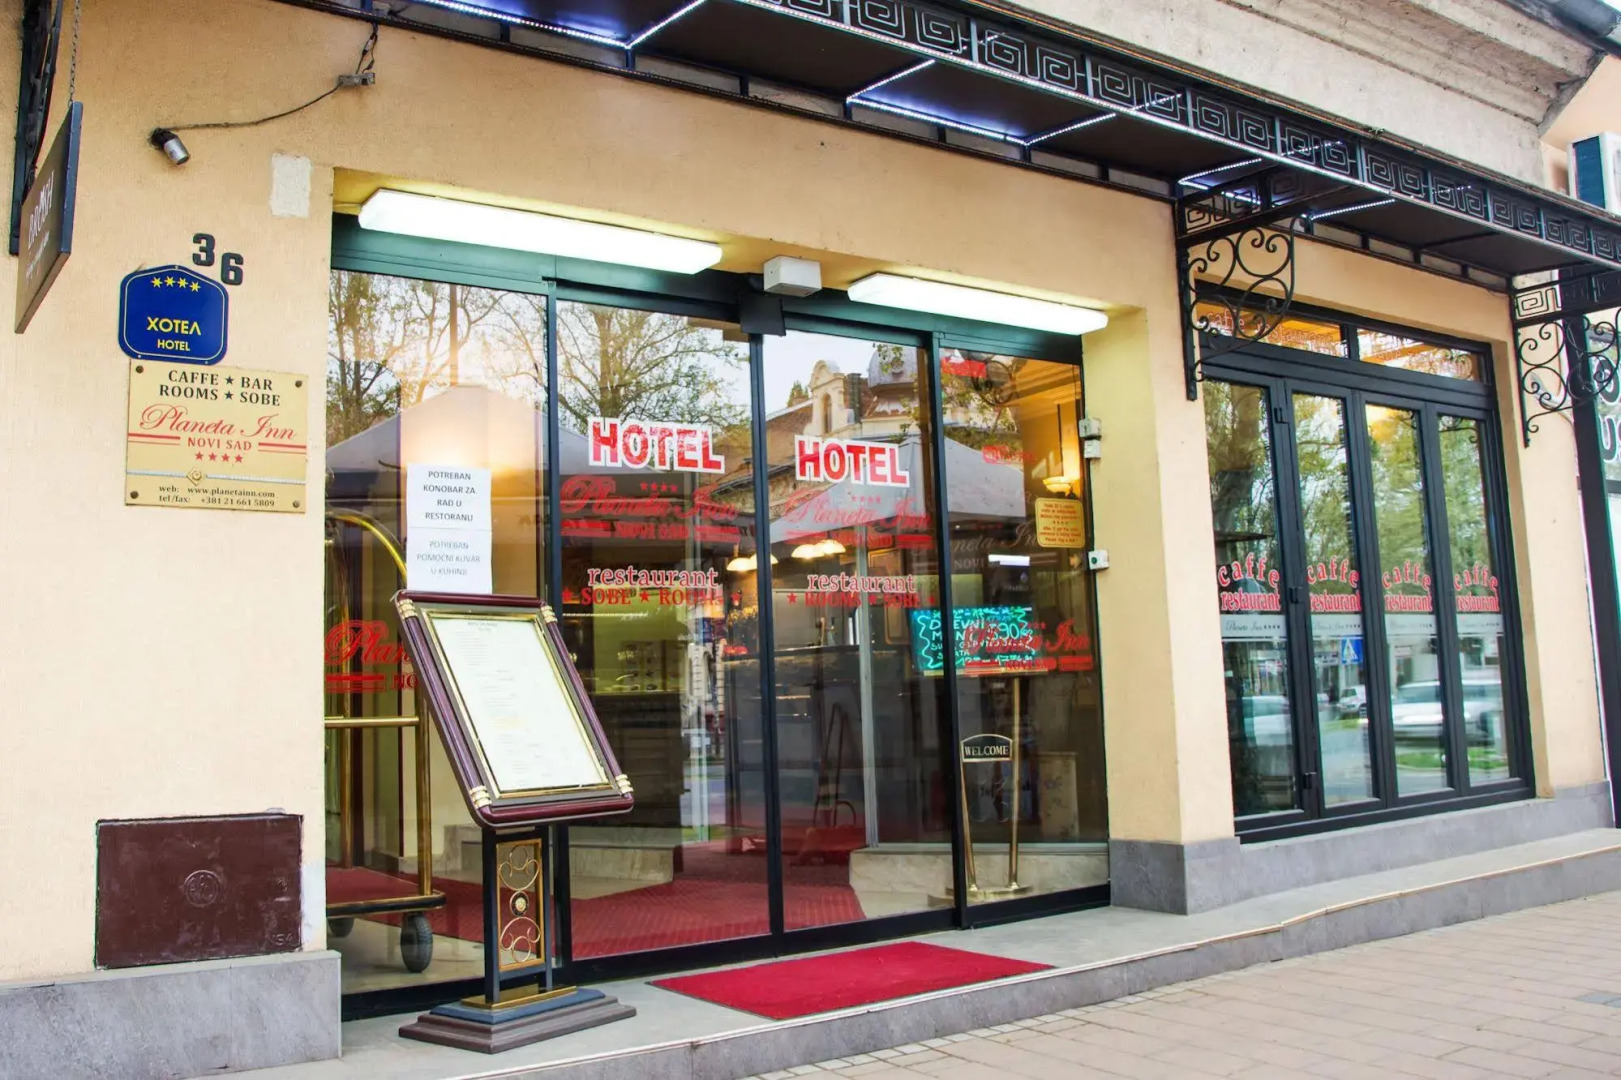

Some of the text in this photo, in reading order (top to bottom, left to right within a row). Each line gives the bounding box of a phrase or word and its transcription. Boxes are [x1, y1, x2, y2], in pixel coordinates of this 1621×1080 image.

[192, 232, 244, 286] 36
[157, 339, 191, 351] HOTEL
[168, 369, 273, 391] CAFFE BAR
[159, 384, 281, 406] ROOMS SOBE
[139, 403, 298, 440] Planeta Inn
[187, 437, 253, 451] NOVI SAD
[590, 418, 724, 472] HOTEL
[796, 437, 908, 486] HOTEL
[428, 471, 471, 480] POTREBAN
[159, 485, 276, 498] web: www.planetainn.com
[423, 484, 476, 494] KONOBAR ZA
[436, 499, 454, 507] RAD
[425, 512, 474, 522] RESTORANU
[429, 540, 469, 549] POTREBAN
[588, 565, 719, 588] restaurant
[1217, 552, 1280, 588] caffe
[1306, 555, 1360, 589] caffe
[1381, 559, 1432, 592] caffe
[1453, 560, 1499, 592] caffe
[807, 571, 917, 593] restaurant
[580, 587, 632, 606] SOBE
[804, 592, 862, 608] ROOMS
[1220, 587, 1281, 611] restaurant
[1384, 590, 1433, 612] restaurant
[1456, 591, 1500, 612] restaurant
[929, 619, 985, 631] DEVNI
[324, 620, 410, 666] Plan
[392, 674, 419, 690] NO
[965, 745, 1009, 756] WELCOME
